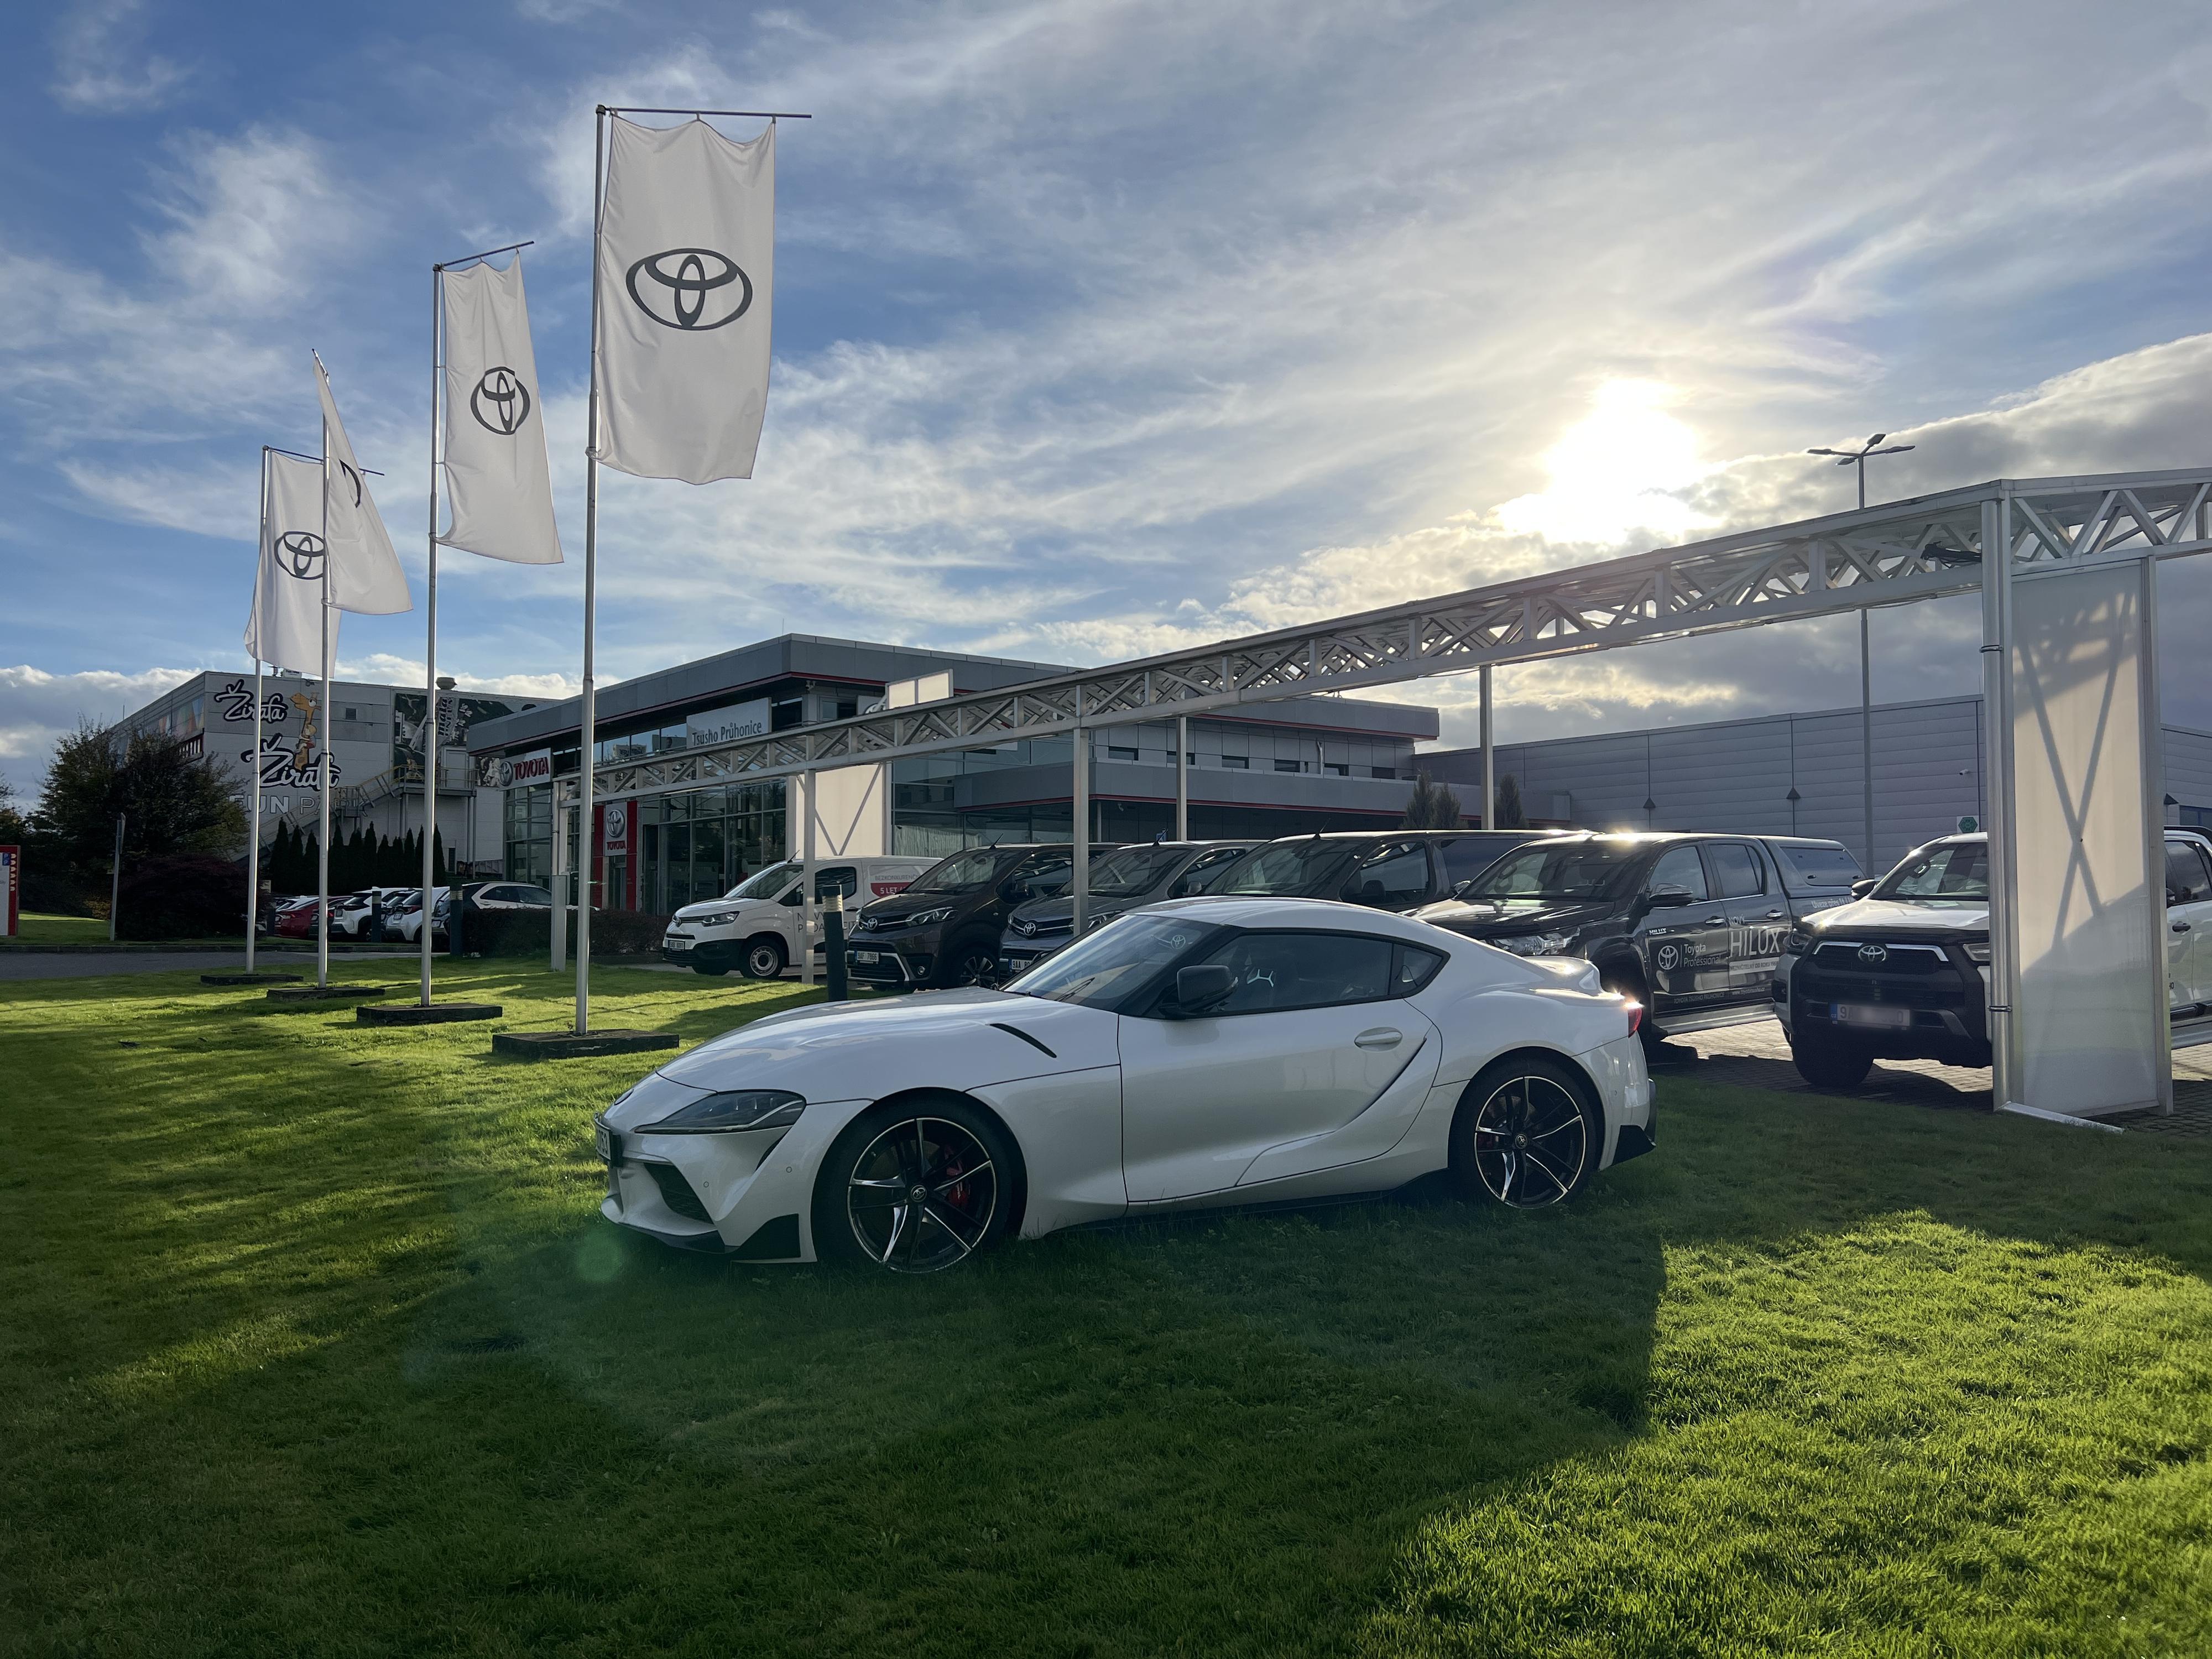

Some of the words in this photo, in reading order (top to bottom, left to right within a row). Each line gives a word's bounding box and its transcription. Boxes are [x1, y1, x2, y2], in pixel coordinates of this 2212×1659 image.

[692, 728, 718, 746] Tsusho
[721, 720, 762, 740] Průhonice
[514, 757, 549, 780] TOYOTA
[300, 796, 368, 817] PRK
[607, 840, 626, 851] TOYOTA
[1728, 914, 1746, 926] NOVÝ
[1684, 943, 1707, 956] Toyota
[1730, 928, 1781, 958] HILUX
[1684, 954, 1721, 968] Professional
